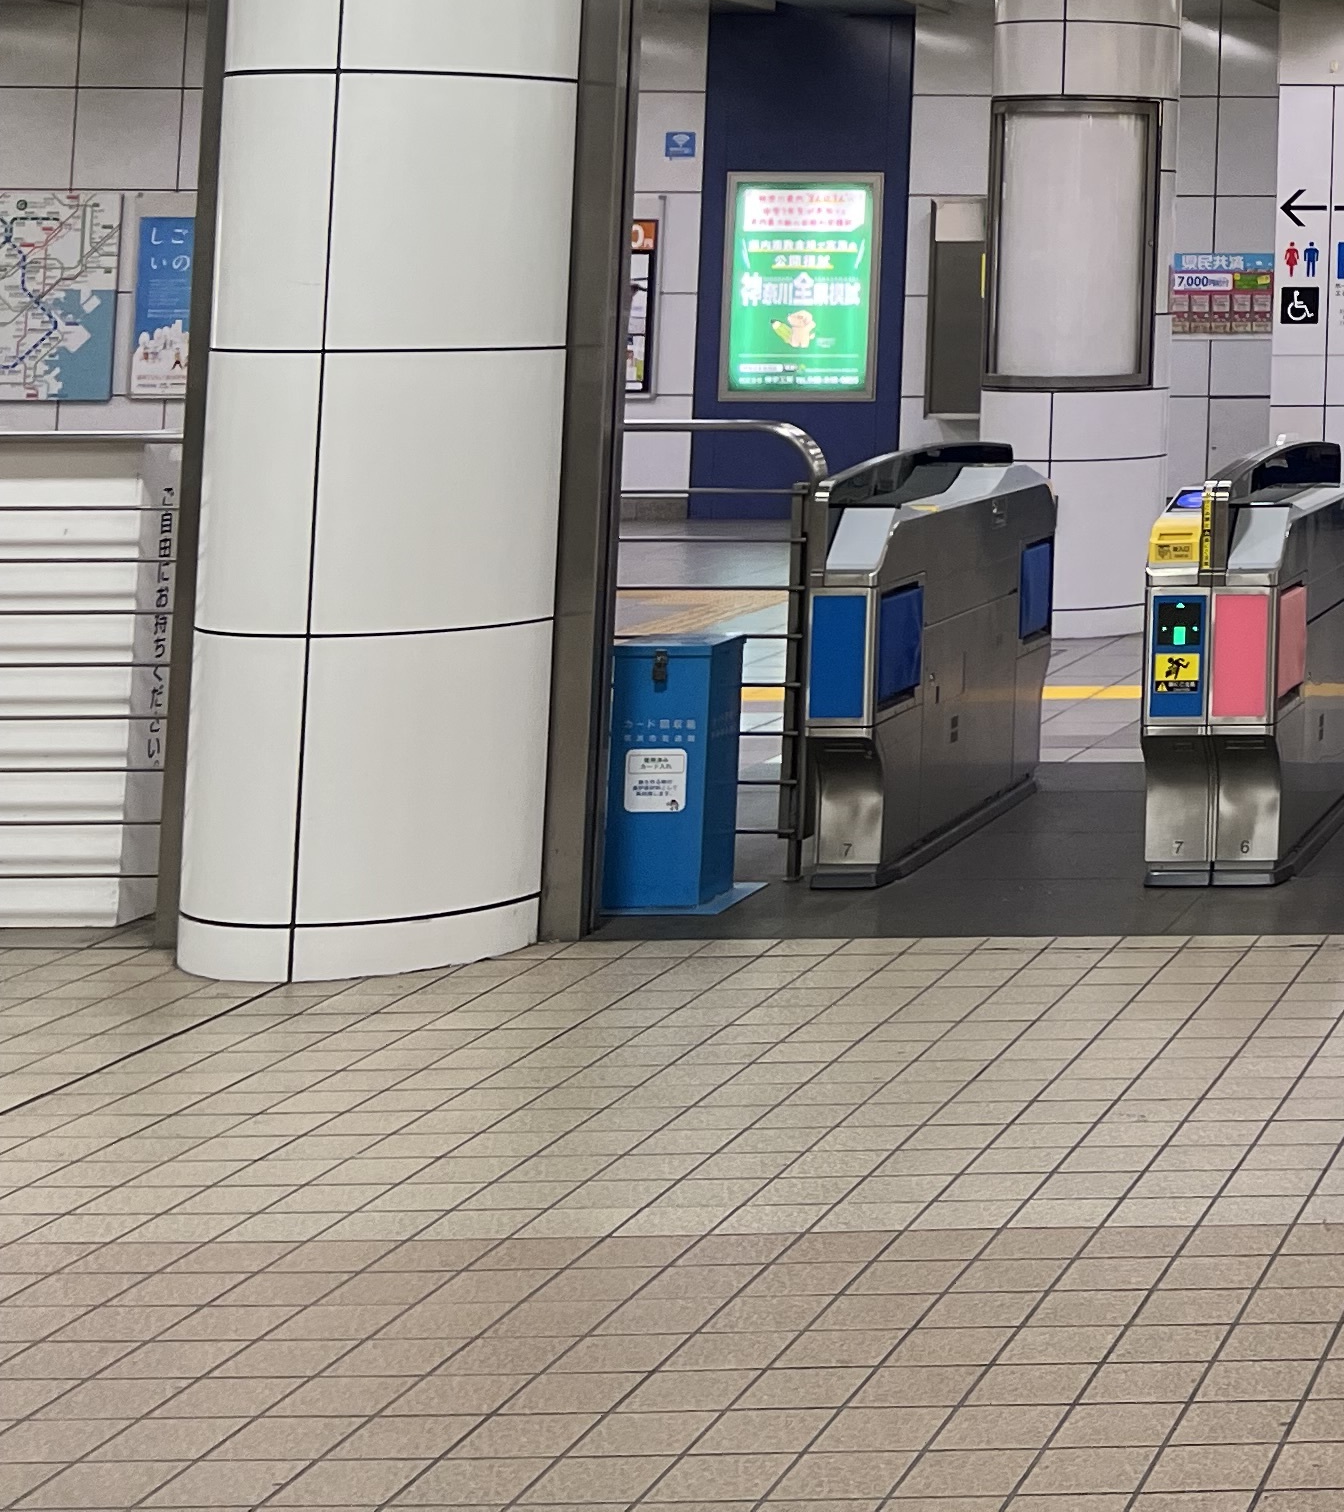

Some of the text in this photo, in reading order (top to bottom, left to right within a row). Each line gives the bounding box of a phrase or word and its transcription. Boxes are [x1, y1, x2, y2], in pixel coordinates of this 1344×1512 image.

[843, 842, 852, 857] 7
[1174, 840, 1184, 854] 7
[1240, 840, 1250, 854] 6
